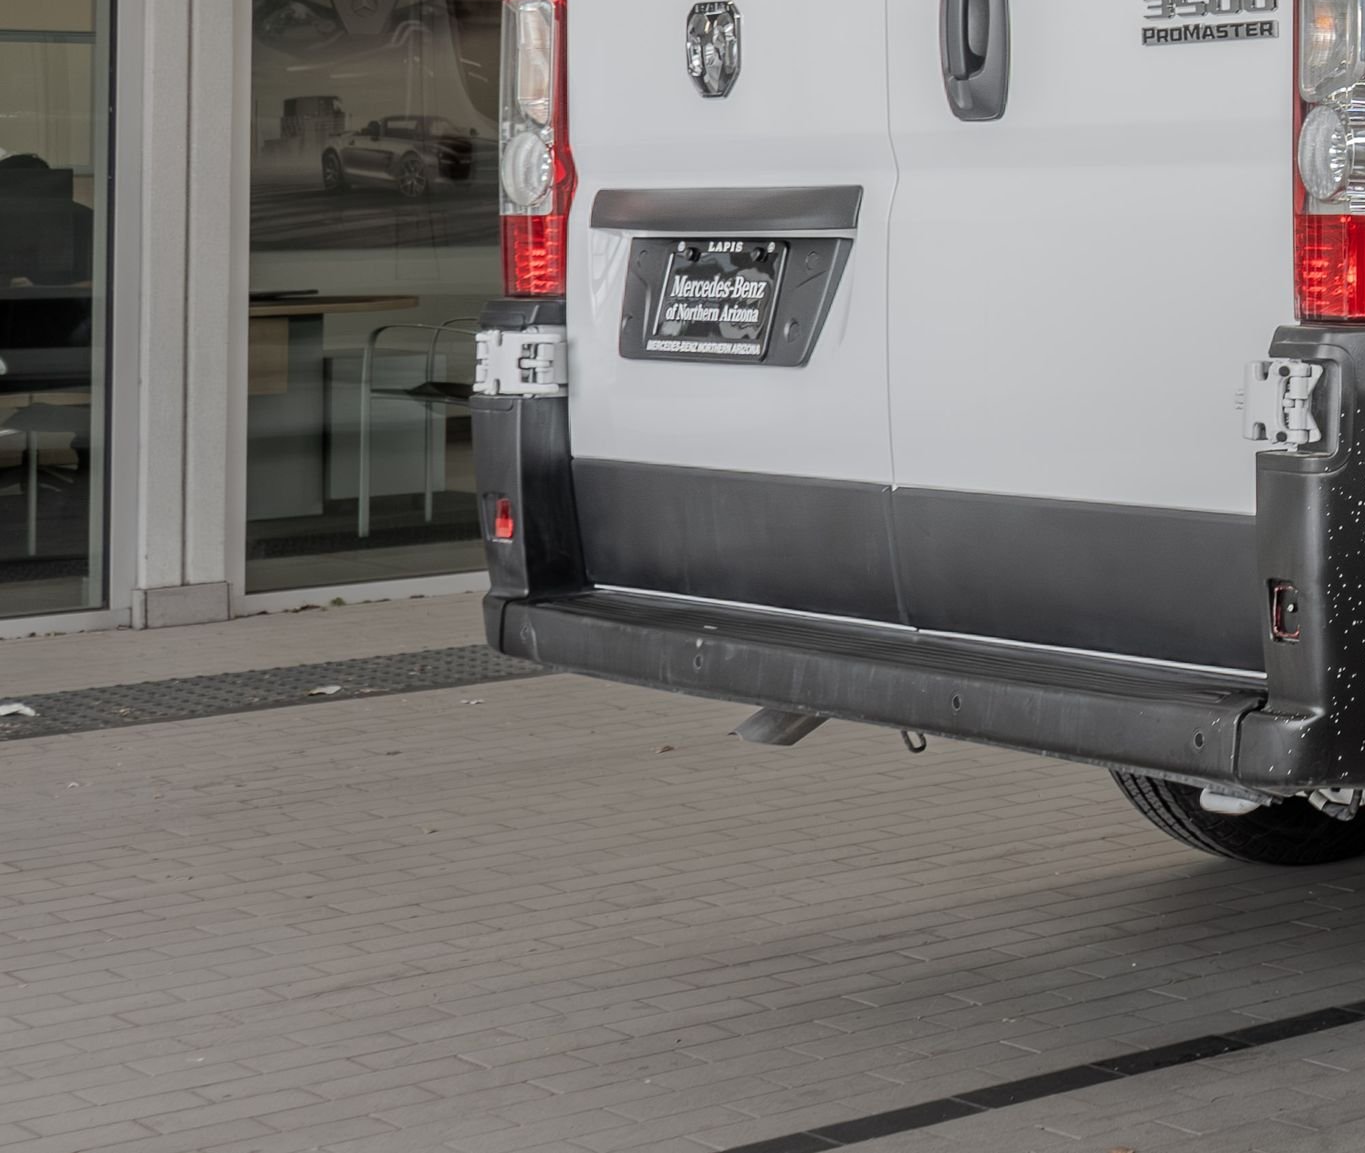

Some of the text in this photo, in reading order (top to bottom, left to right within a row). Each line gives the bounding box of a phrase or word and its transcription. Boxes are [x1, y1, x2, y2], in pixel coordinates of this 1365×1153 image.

[670, 275, 767, 299] Mercedes-Benz
[665, 304, 759, 323] of Northern Arizona
